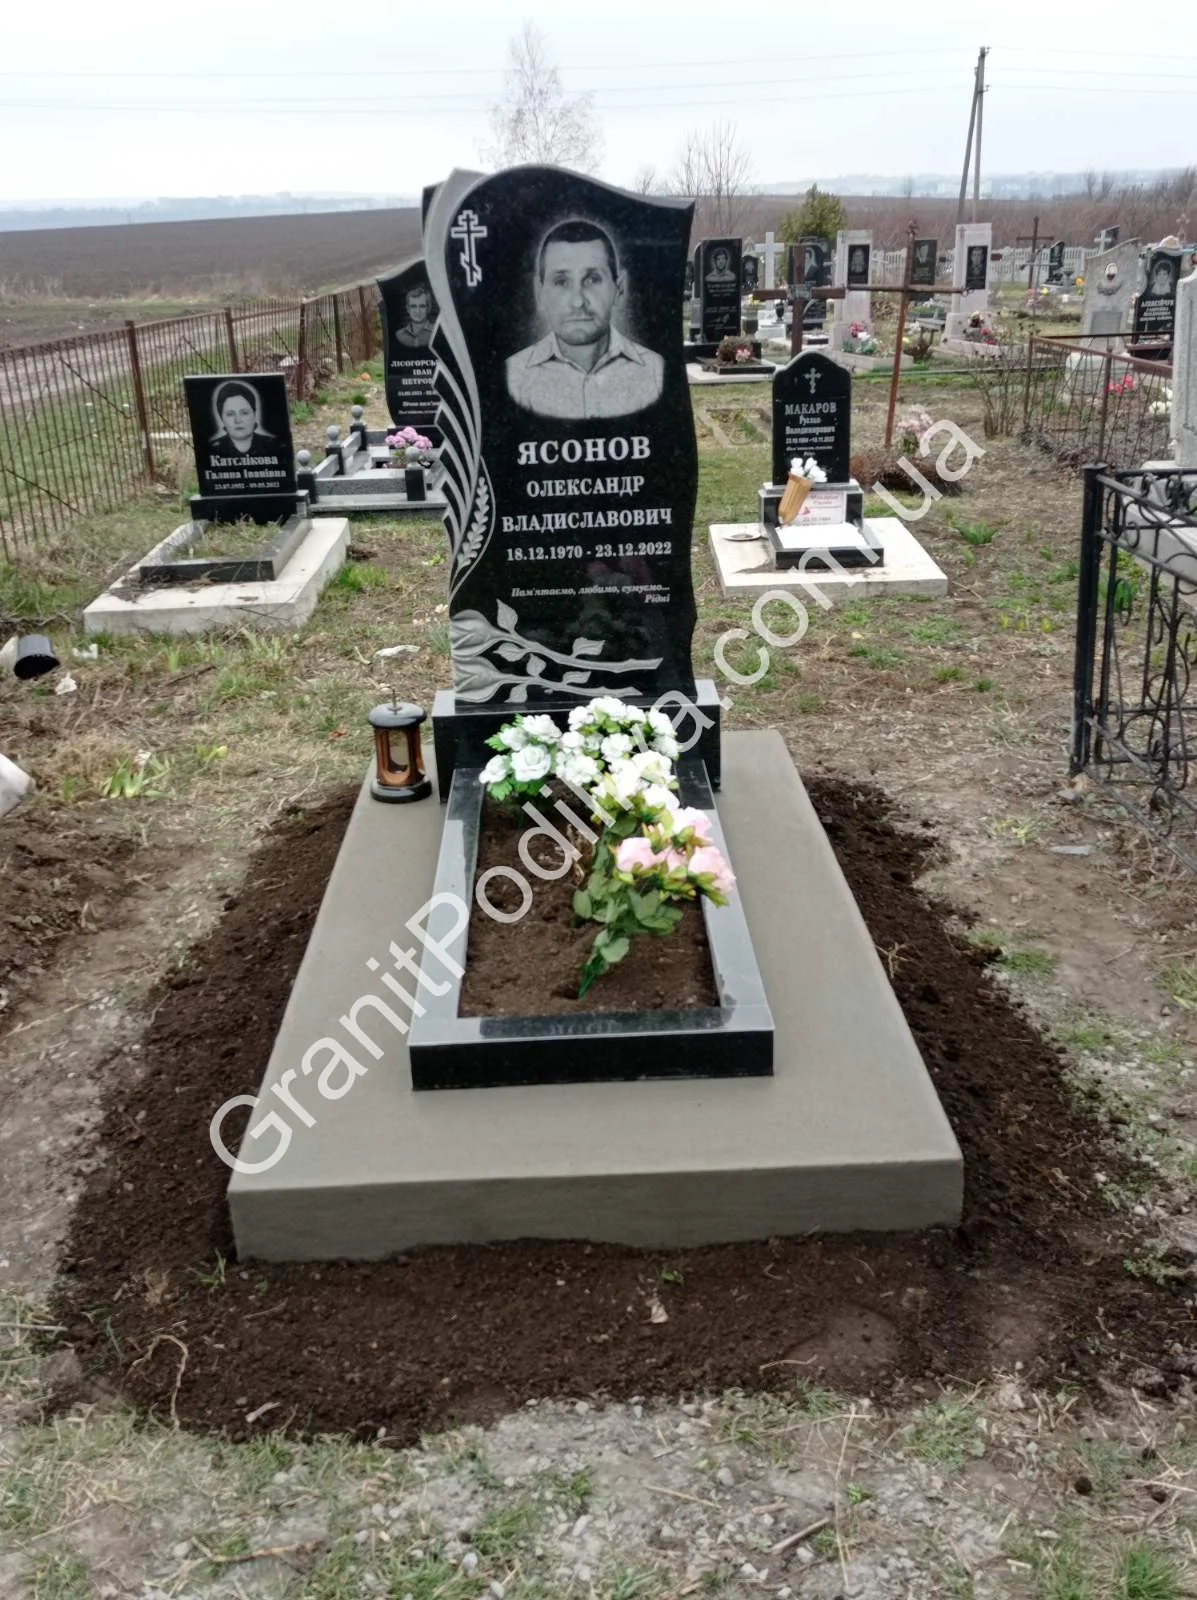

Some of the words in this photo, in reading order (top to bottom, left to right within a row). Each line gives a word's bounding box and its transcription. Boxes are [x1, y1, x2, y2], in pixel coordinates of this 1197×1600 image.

[785, 402, 837, 415] МАКАРОВ
[516, 436, 652, 465] ЯСОНОВ
[526, 475, 646, 498] ОЛЕКСАНДР
[501, 508, 673, 533] ВЛАДИСЛАВОВИЧ
[507, 546, 583, 561] 18.12.1970
[595, 541, 672, 558] 23.12.2022
